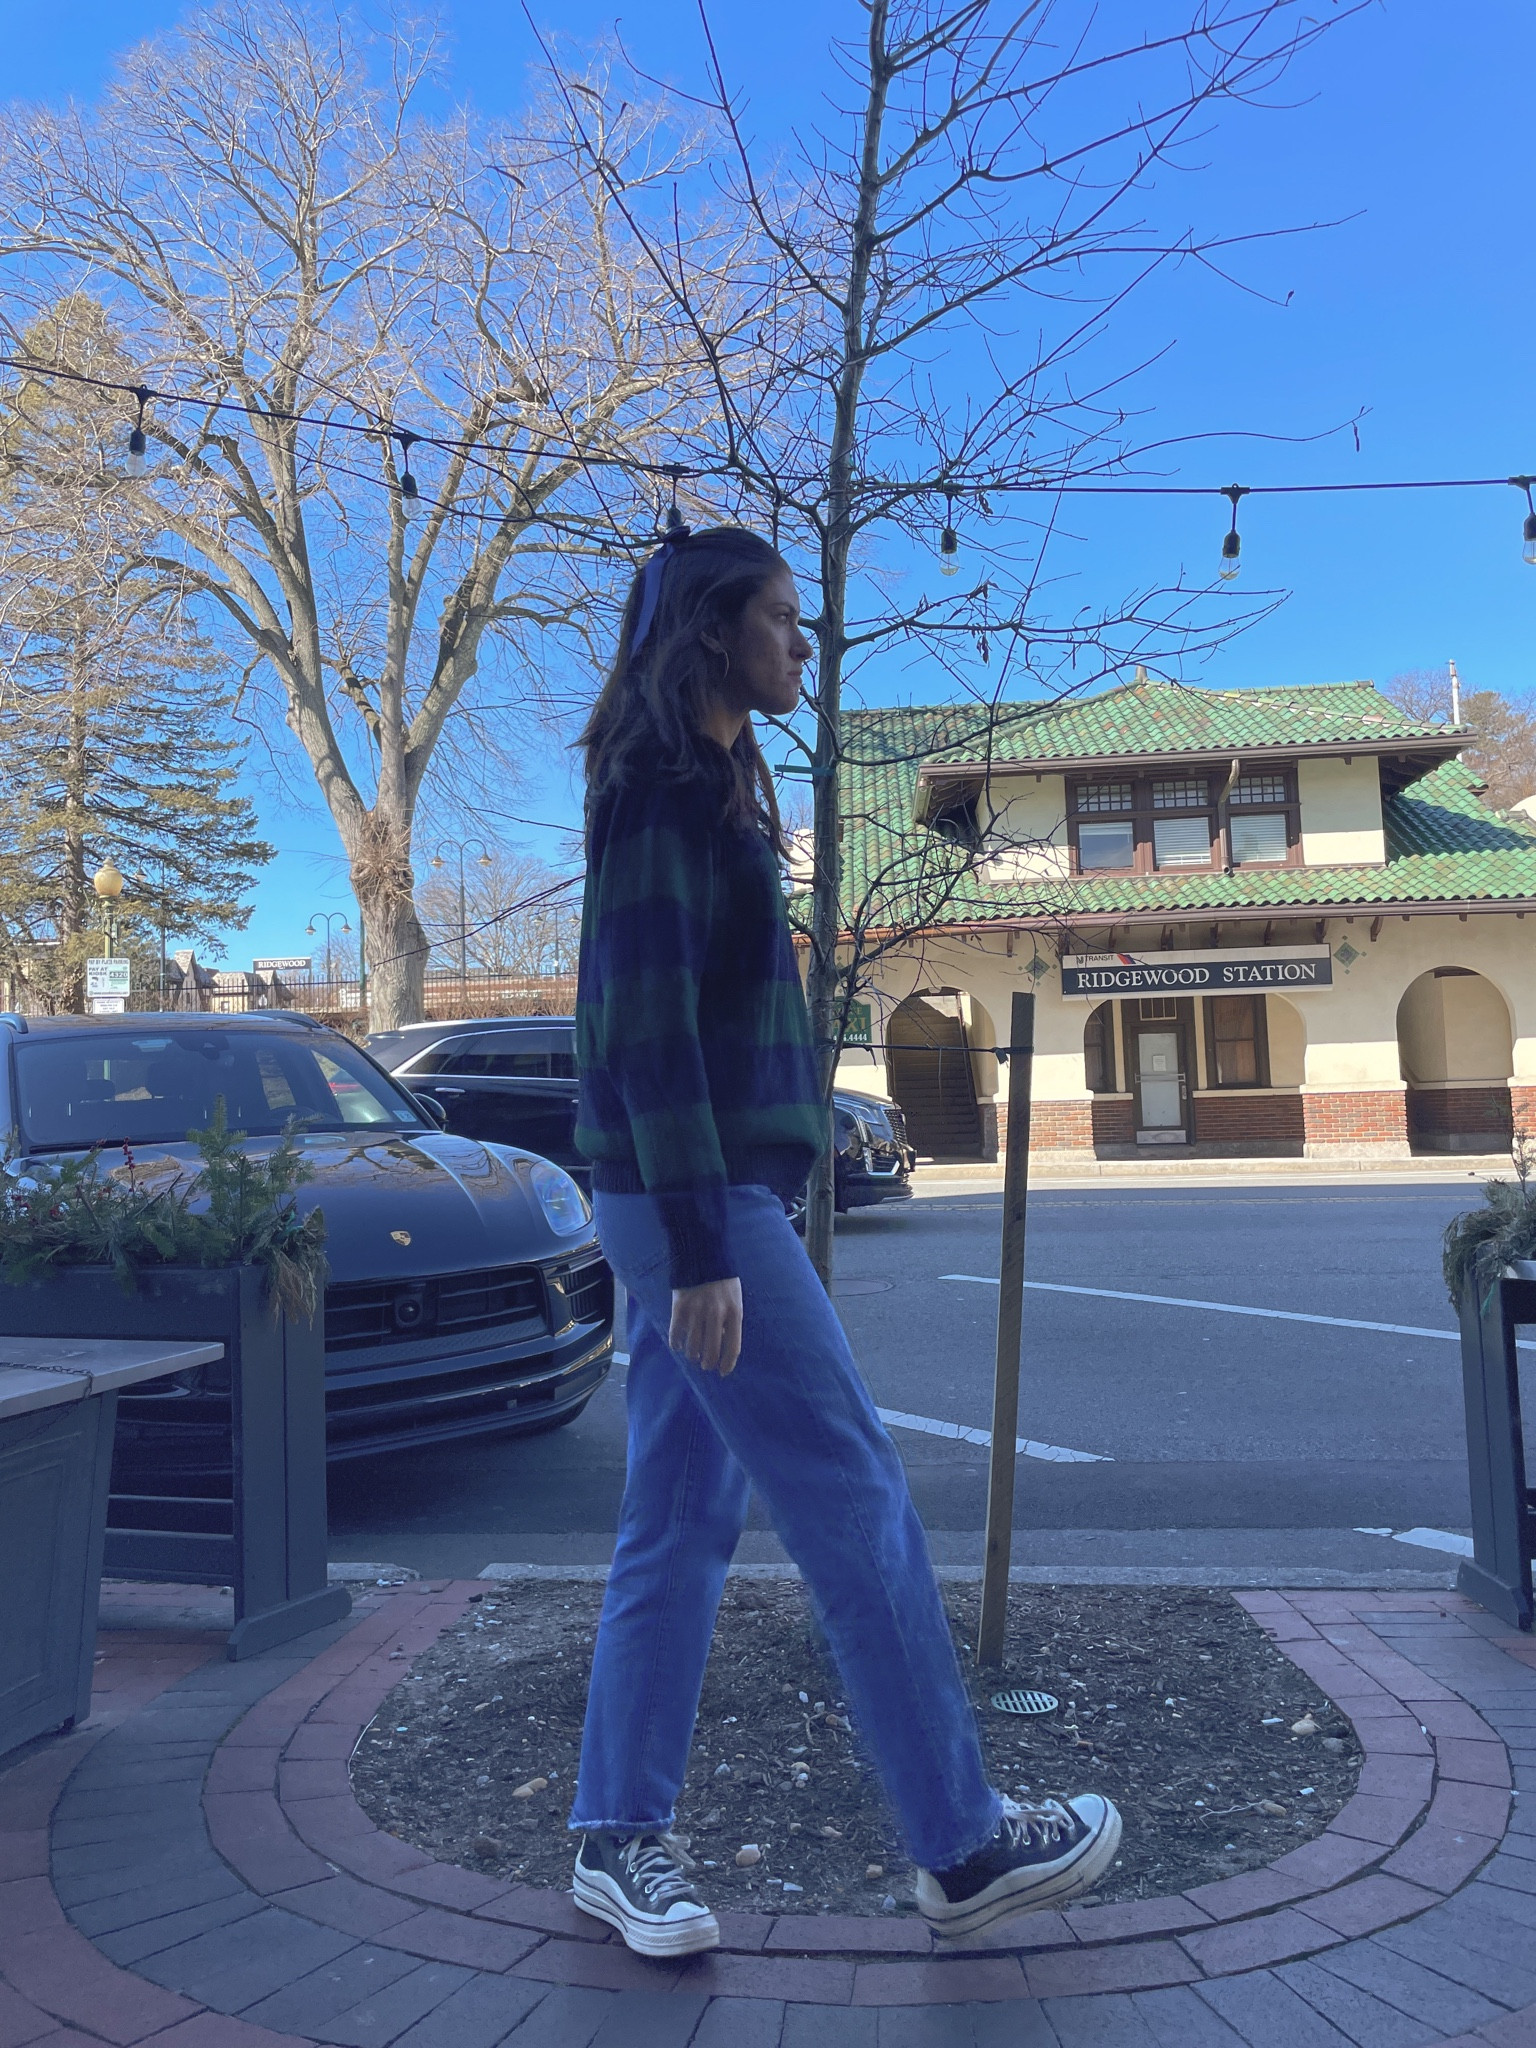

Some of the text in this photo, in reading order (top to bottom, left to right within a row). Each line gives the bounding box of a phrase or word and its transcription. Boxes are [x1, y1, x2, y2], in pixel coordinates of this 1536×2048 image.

[1084, 954, 1114, 962] TRANSIT
[258, 960, 306, 968] RIDGEWOOD
[1077, 963, 1317, 989] RIDGEWOOD STATION
